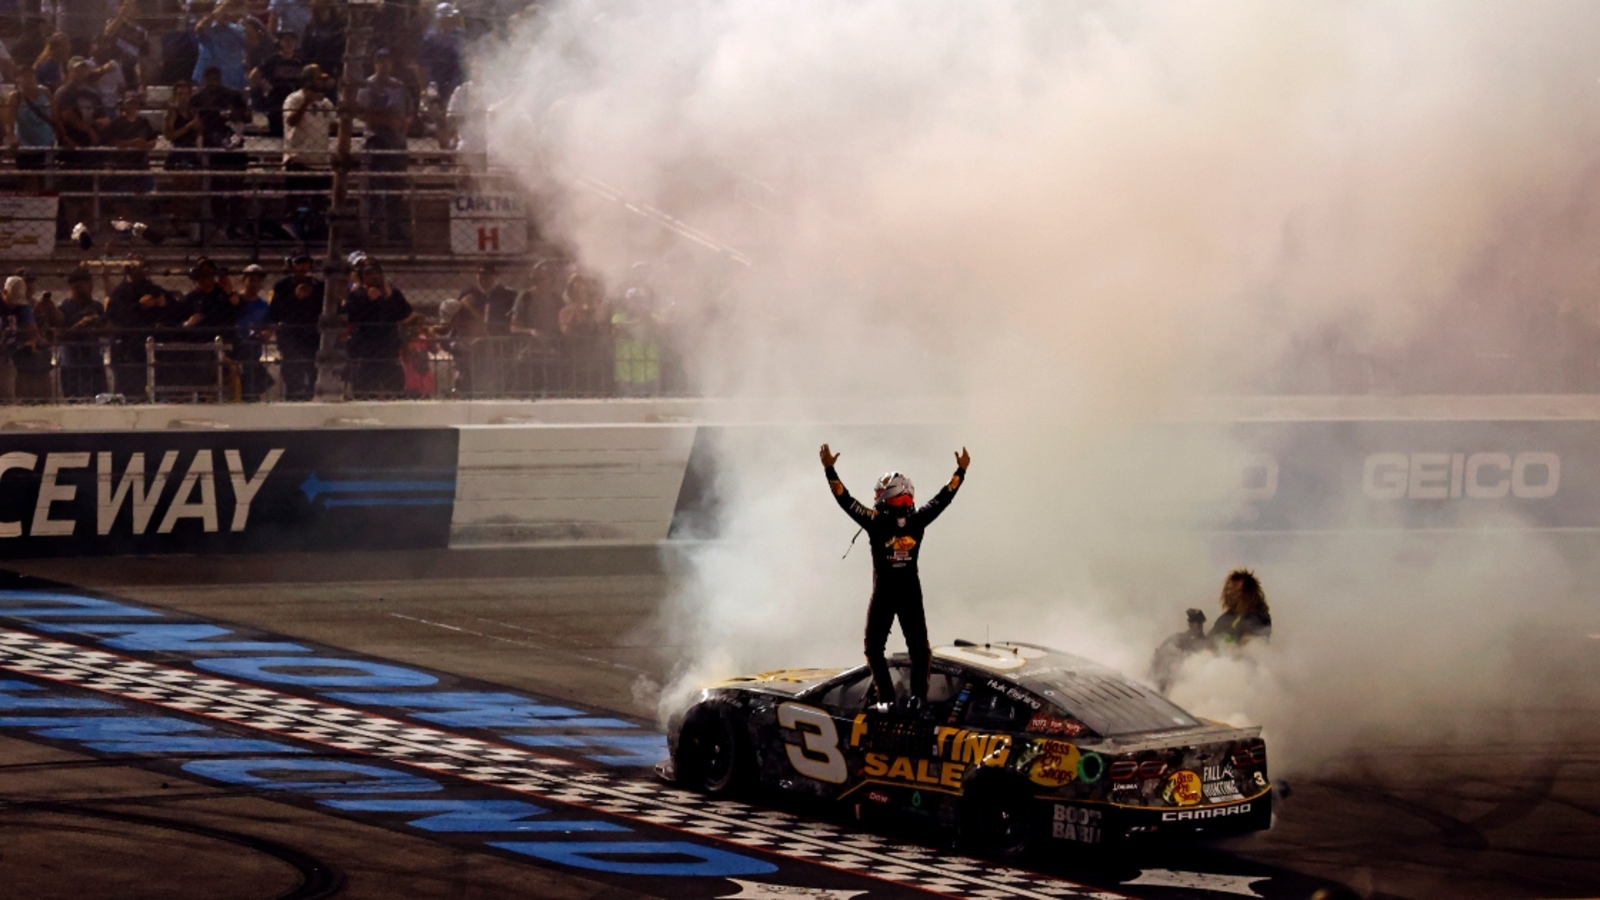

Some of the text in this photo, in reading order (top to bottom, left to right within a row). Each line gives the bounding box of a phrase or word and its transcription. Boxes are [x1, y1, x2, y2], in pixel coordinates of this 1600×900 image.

[478, 227, 499, 251] H
[1362, 452, 1561, 499] GEICO
[777, 701, 849, 785] 3
[864, 752, 965, 788] SALE
[1253, 771, 1266, 786] 3
[1162, 803, 1251, 822] CAMARO
